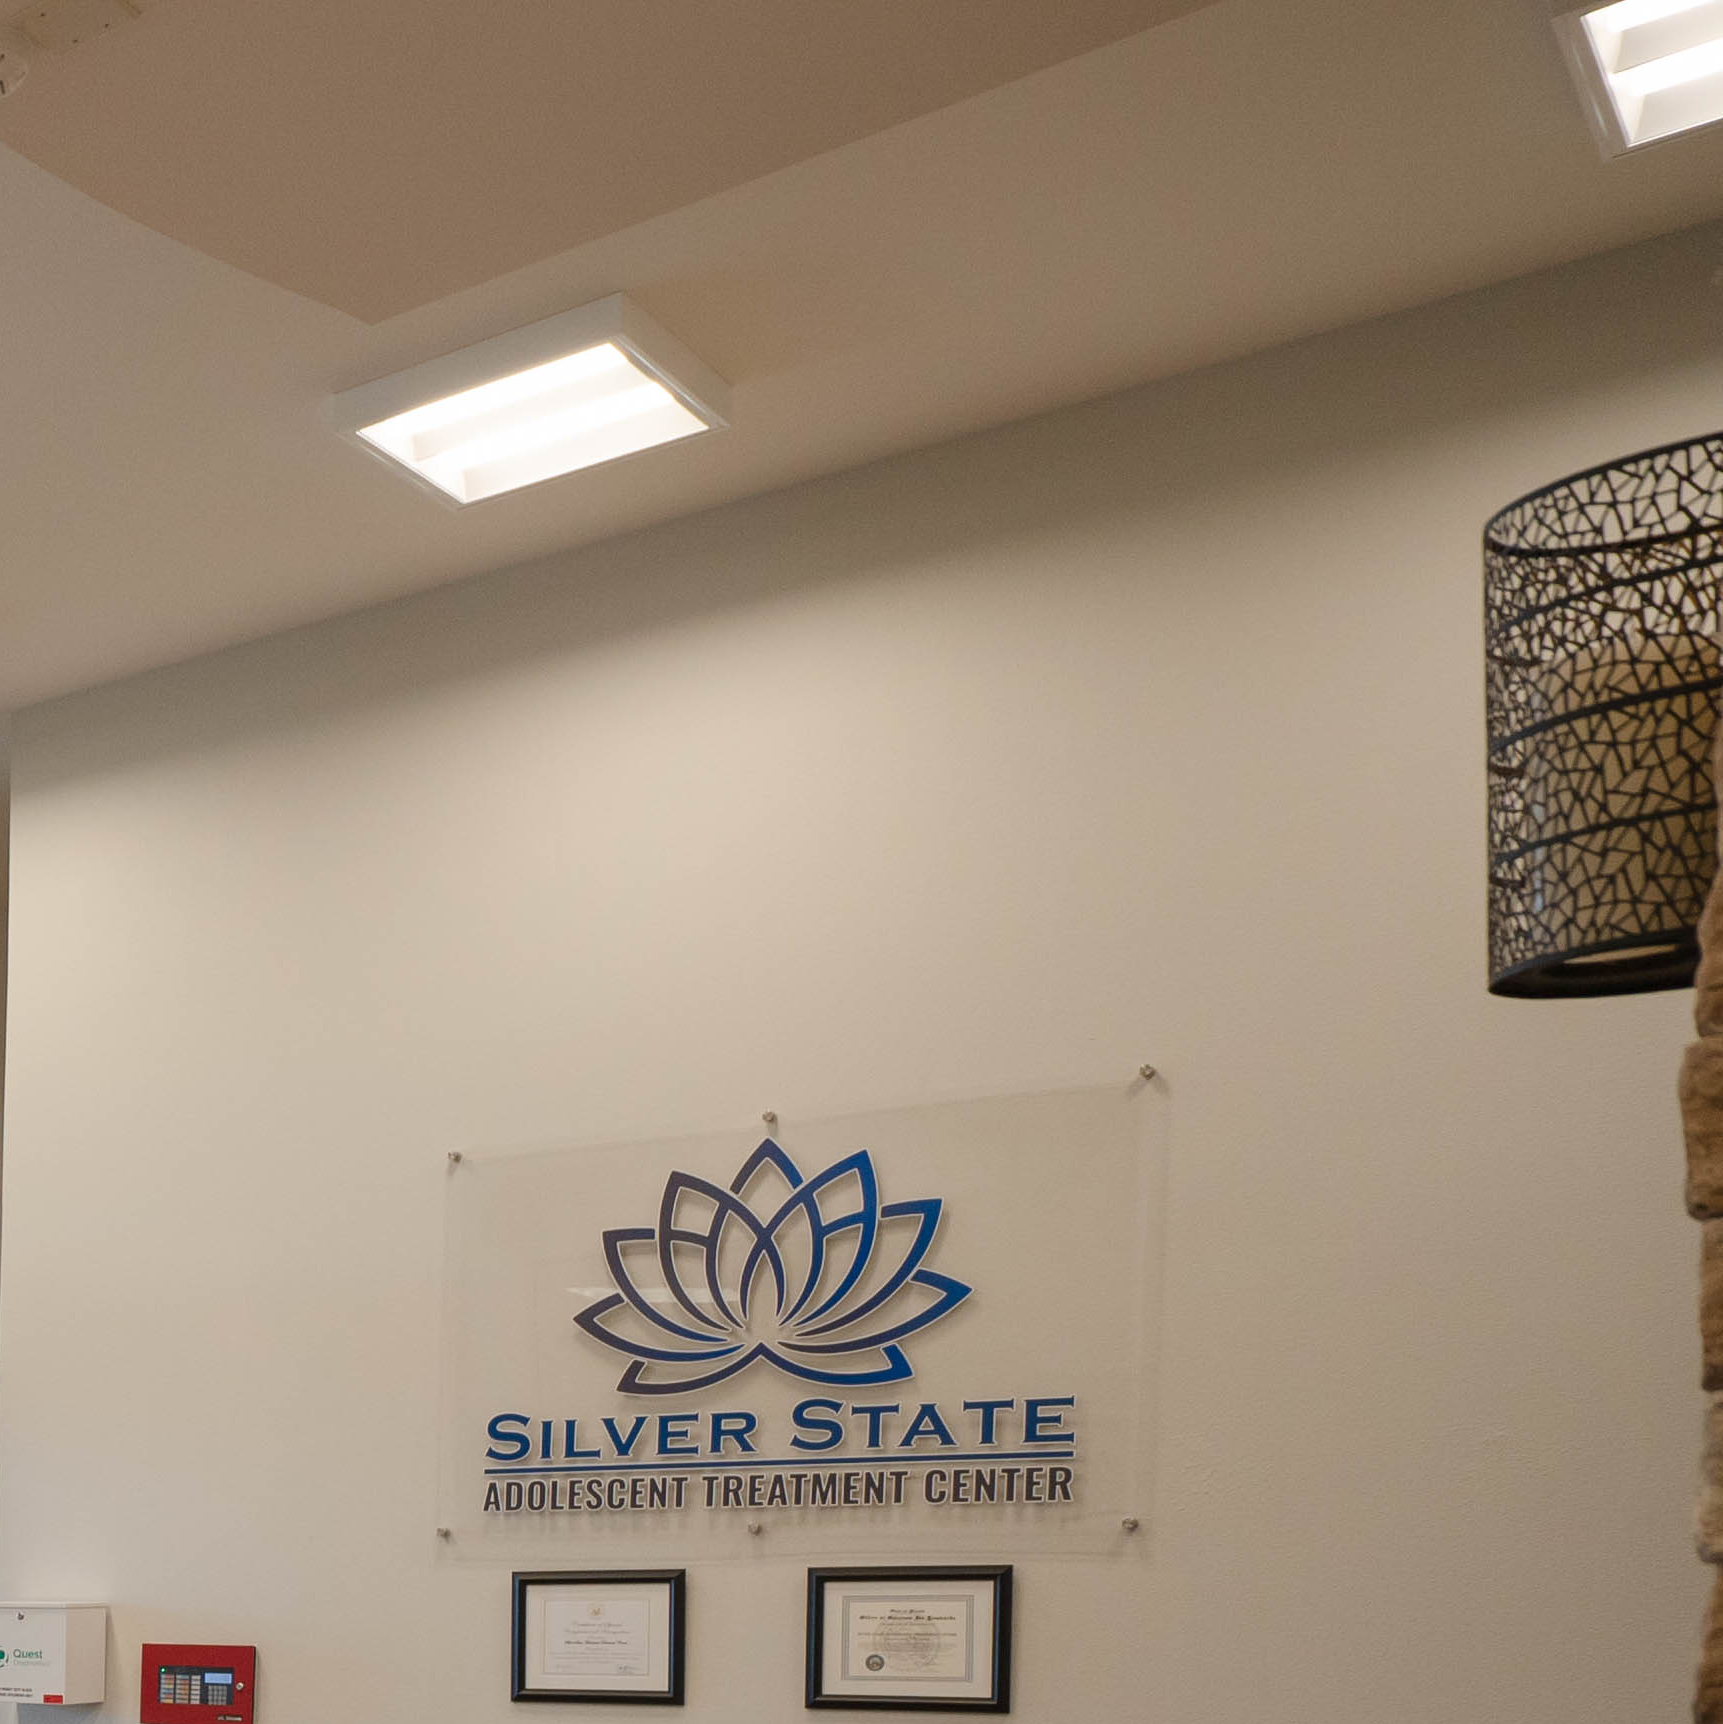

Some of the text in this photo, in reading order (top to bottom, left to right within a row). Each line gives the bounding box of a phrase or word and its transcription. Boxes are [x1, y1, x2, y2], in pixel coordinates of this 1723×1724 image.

[483, 1395, 1077, 1461] SILVER STATE
[483, 1465, 1076, 1513] ADOLESCENT TREATMENT CENTER
[12, 1648, 43, 1659] Quest
